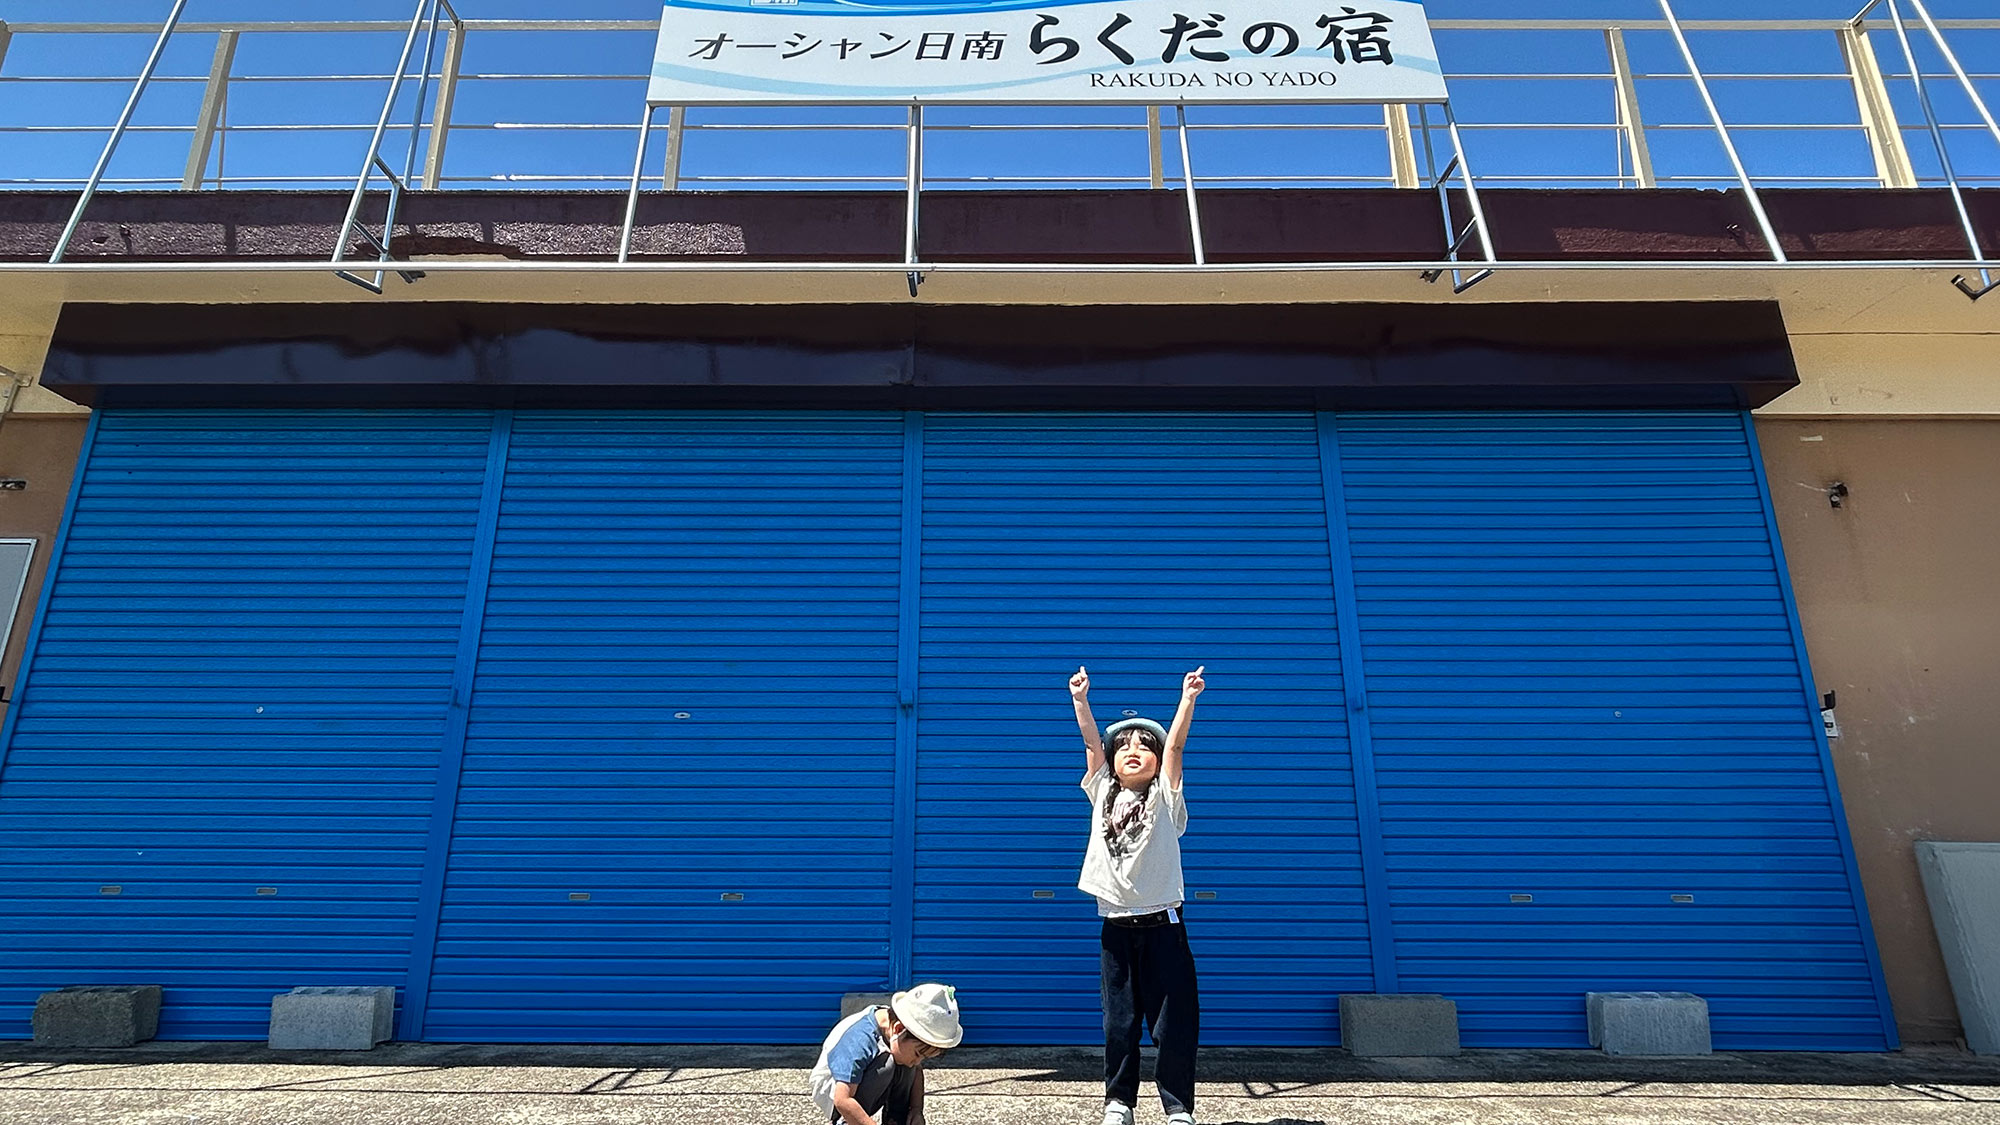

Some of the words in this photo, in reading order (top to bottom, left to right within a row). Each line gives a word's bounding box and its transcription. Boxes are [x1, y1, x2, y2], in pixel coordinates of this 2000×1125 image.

[688, 31, 1008, 60] オーシャン日南
[1028, 6, 1395, 66] らくだの宿
[1089, 72, 1204, 88] RAKUDA
[1214, 72, 1254, 87] NO
[1260, 71, 1338, 87] YADO
